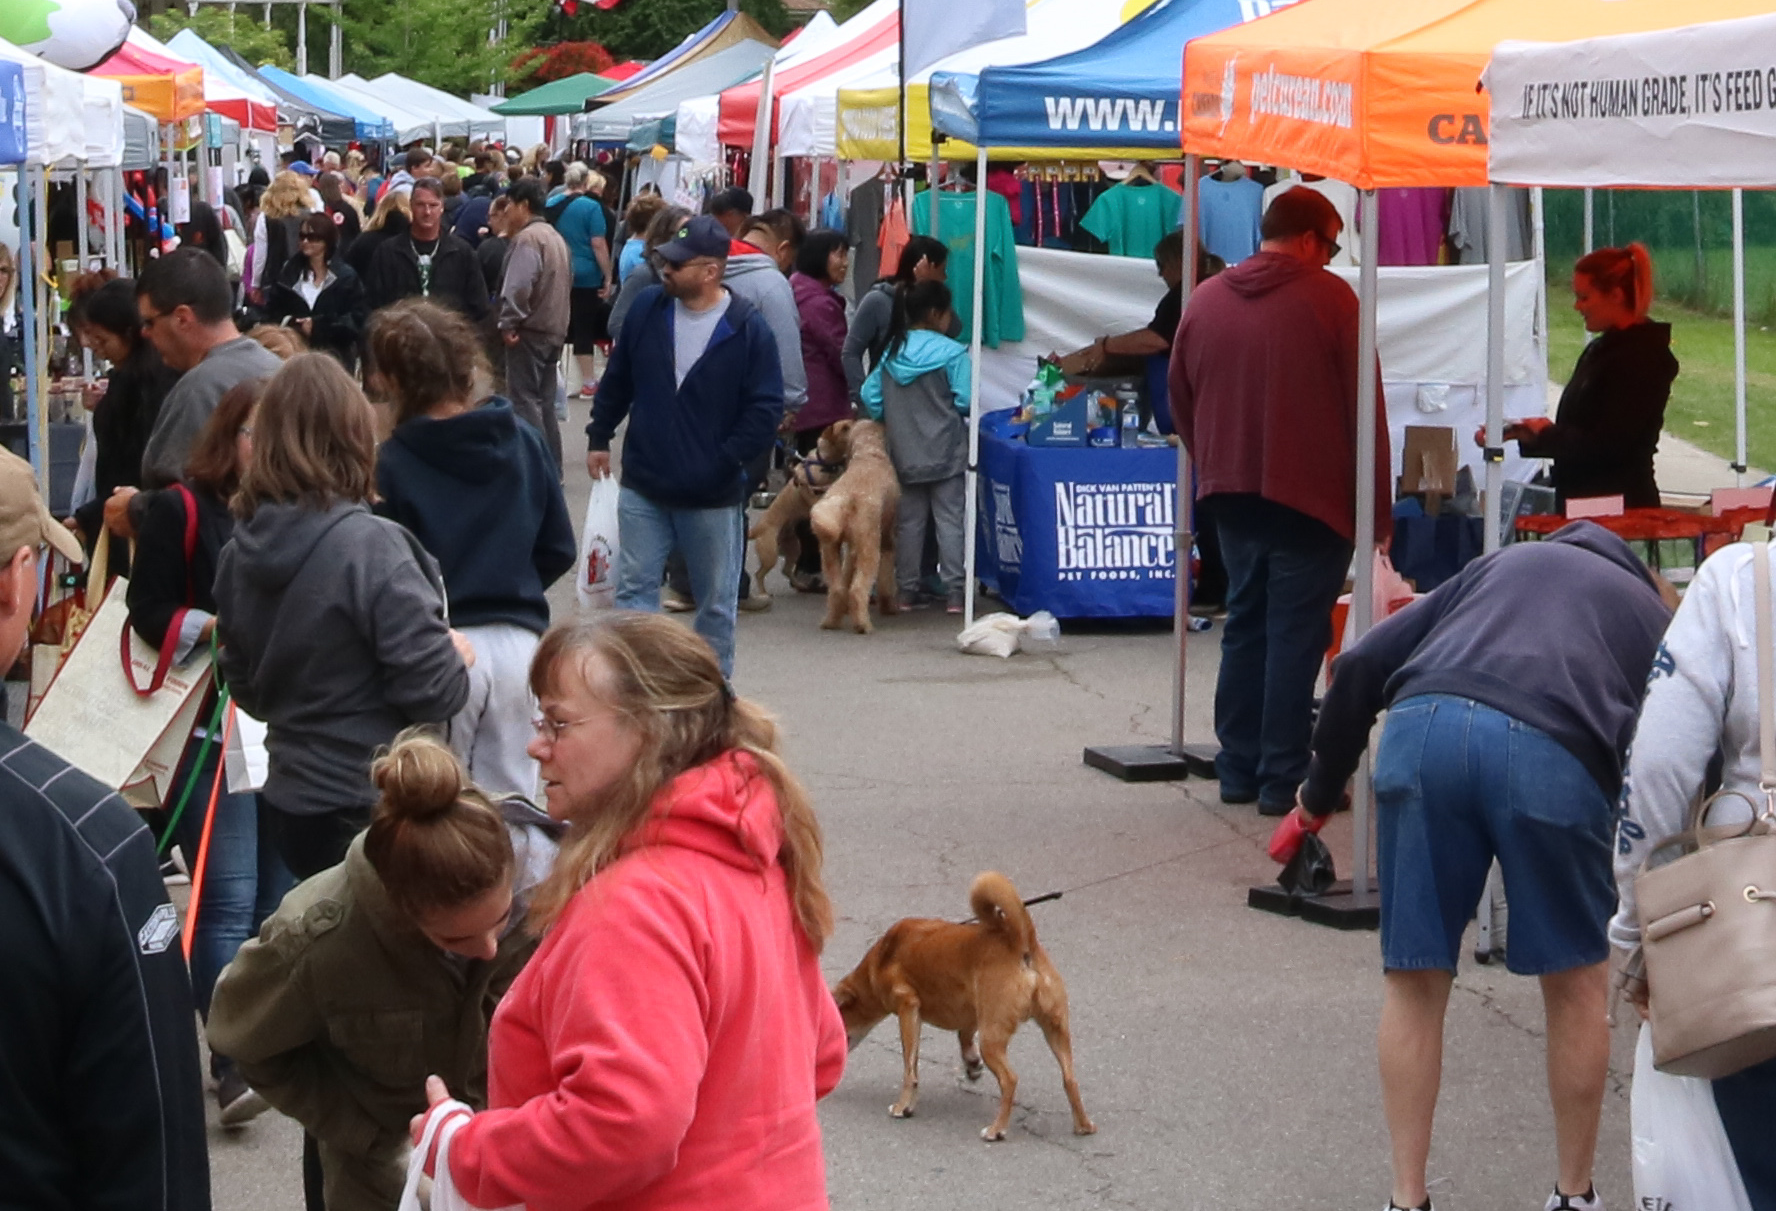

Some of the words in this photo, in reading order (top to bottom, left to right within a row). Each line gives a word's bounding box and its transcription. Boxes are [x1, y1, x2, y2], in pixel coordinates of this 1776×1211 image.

[1250, 63, 1353, 128] petcurean.com
[1523, 83, 1534, 120] IF
[1537, 82, 1559, 119] IT'S
[1561, 81, 1588, 119] NOT
[1589, 78, 1639, 118] HUMAN
[1642, 75, 1691, 117] GRADE,
[1695, 72, 1722, 113] IT'S
[1726, 69, 1762, 110] FEED
[1055, 482, 1173, 527] Natural
[1076, 484, 1097, 493] DICK
[1099, 483, 1120, 492] VAN
[1122, 483, 1161, 492] PATTEN'S
[1058, 526, 1174, 569] Balance
[1059, 572, 1082, 580] PET
